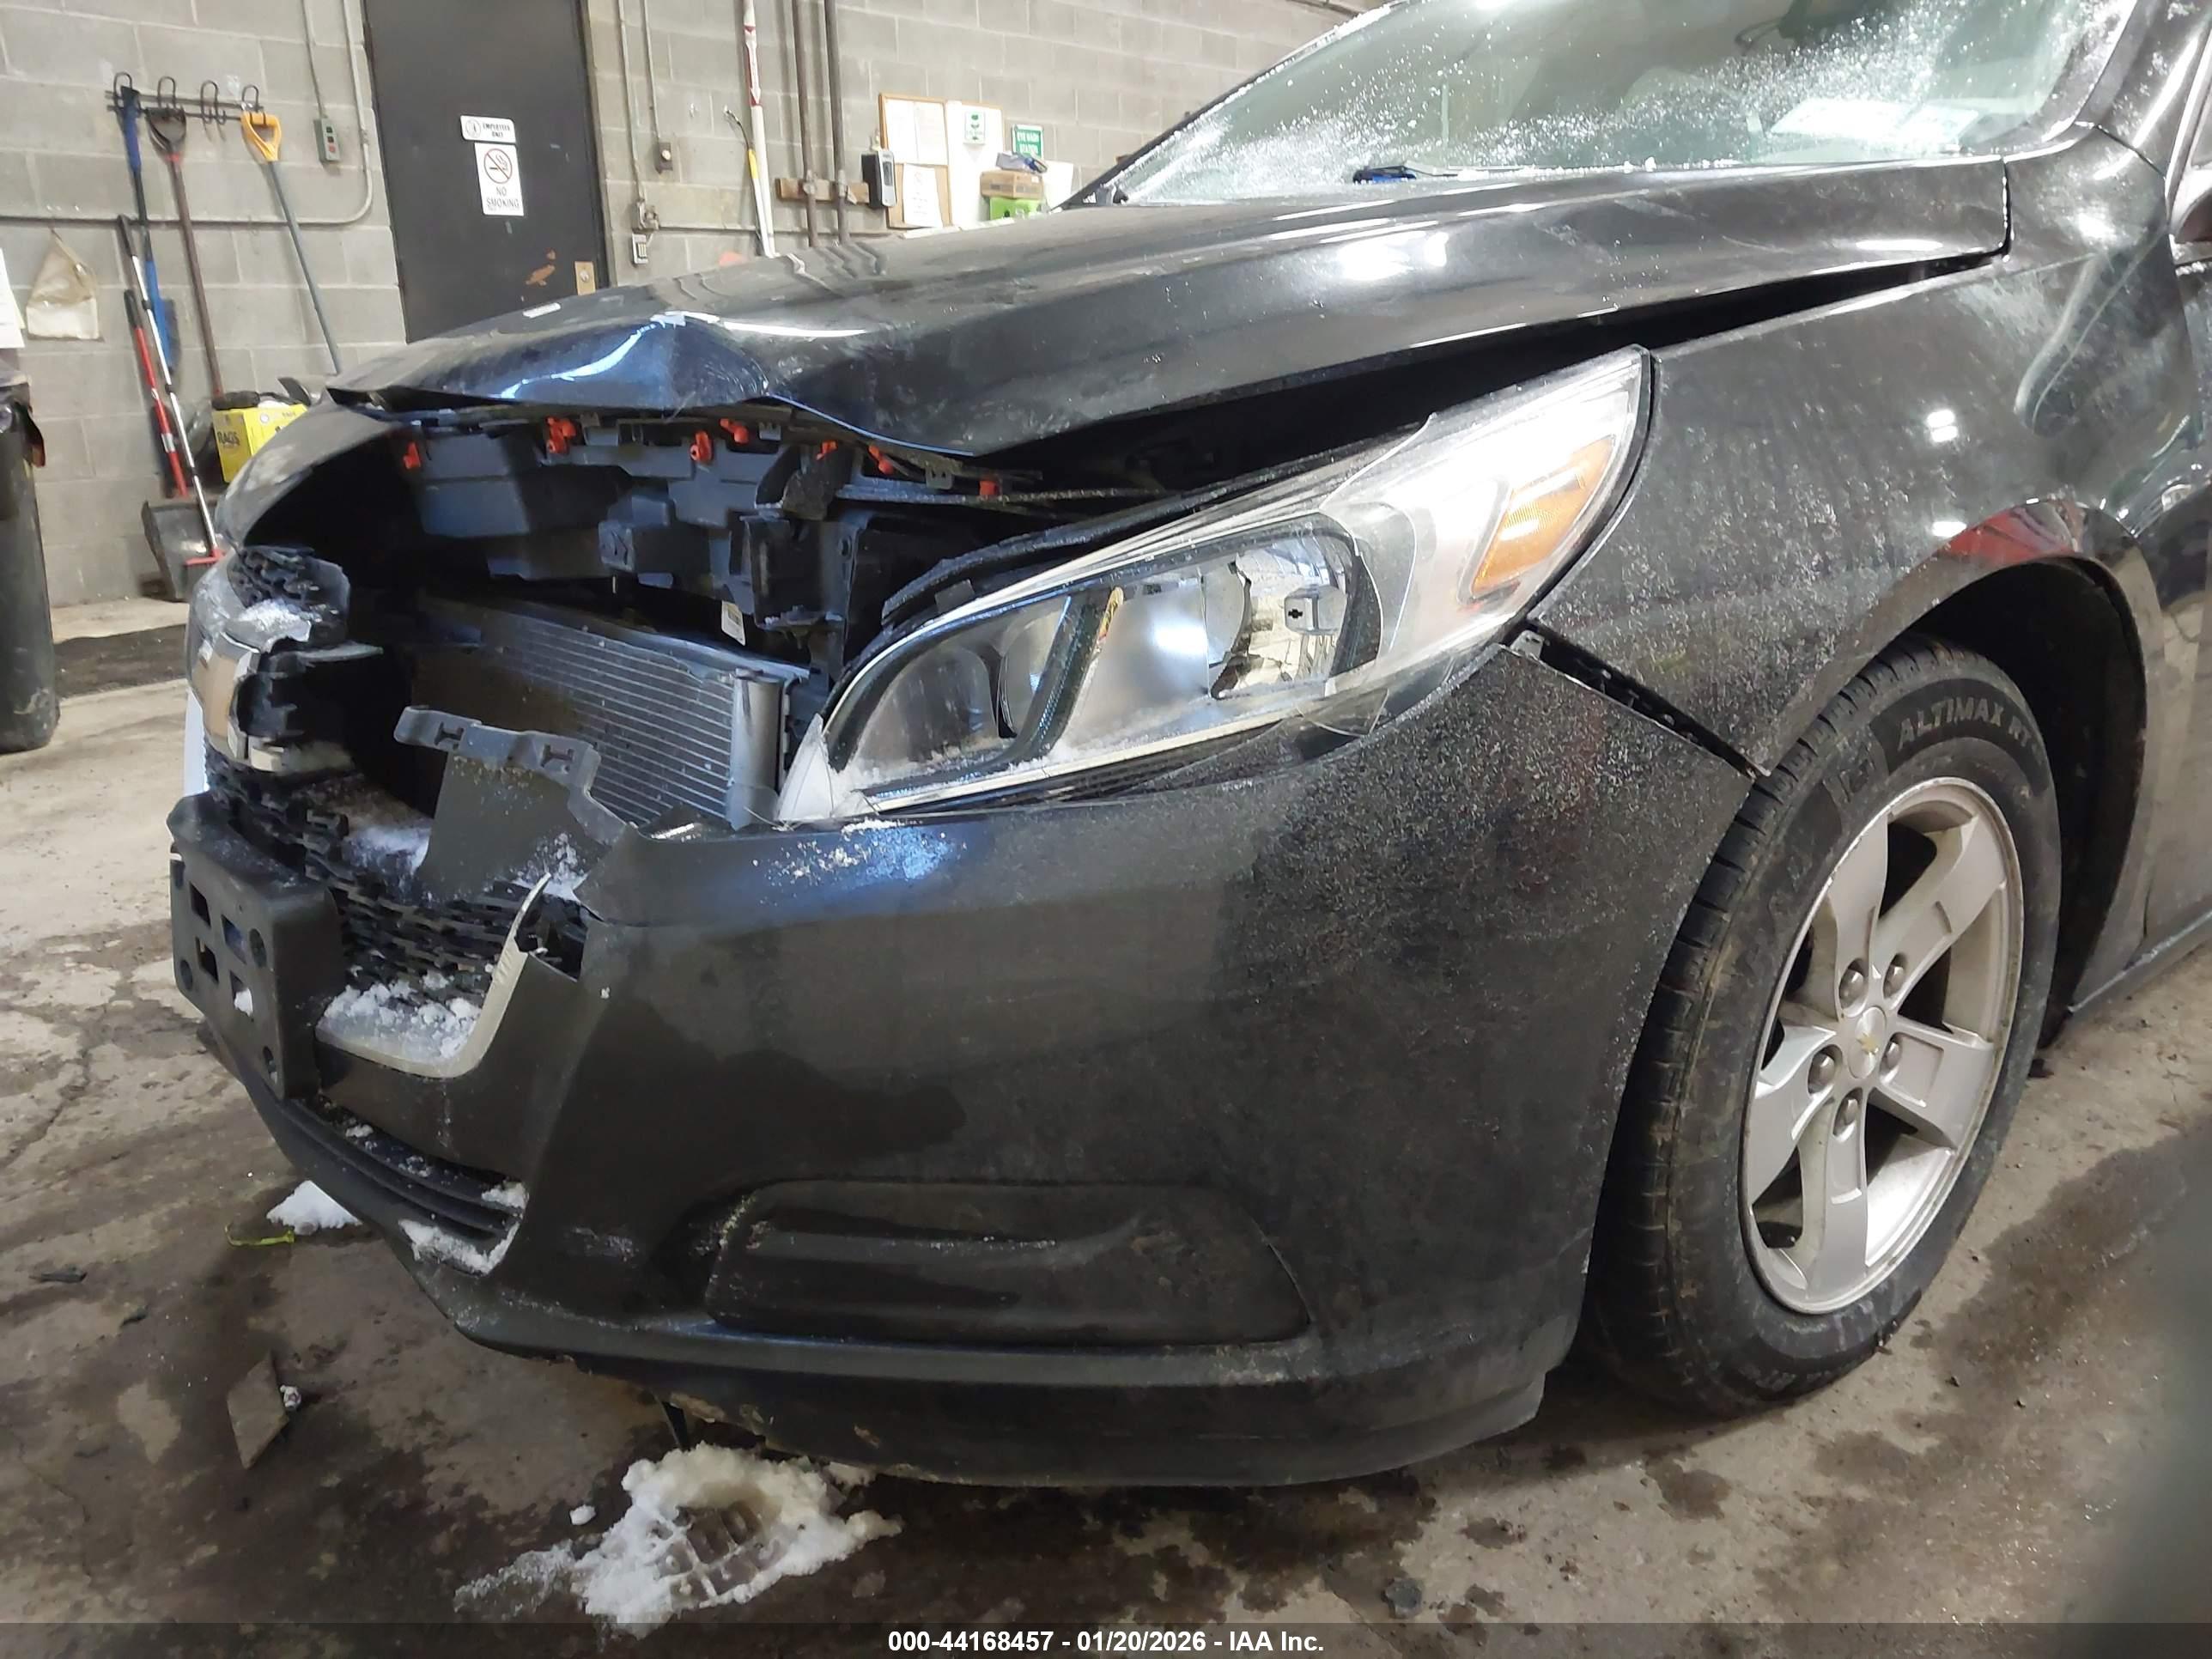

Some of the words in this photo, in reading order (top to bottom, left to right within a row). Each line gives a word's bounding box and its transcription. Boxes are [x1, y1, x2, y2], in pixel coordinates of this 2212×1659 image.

[495, 186, 507, 197] NO
[486, 198, 520, 208] SMOKING
[1897, 696, 2004, 751] ALTIMAX
